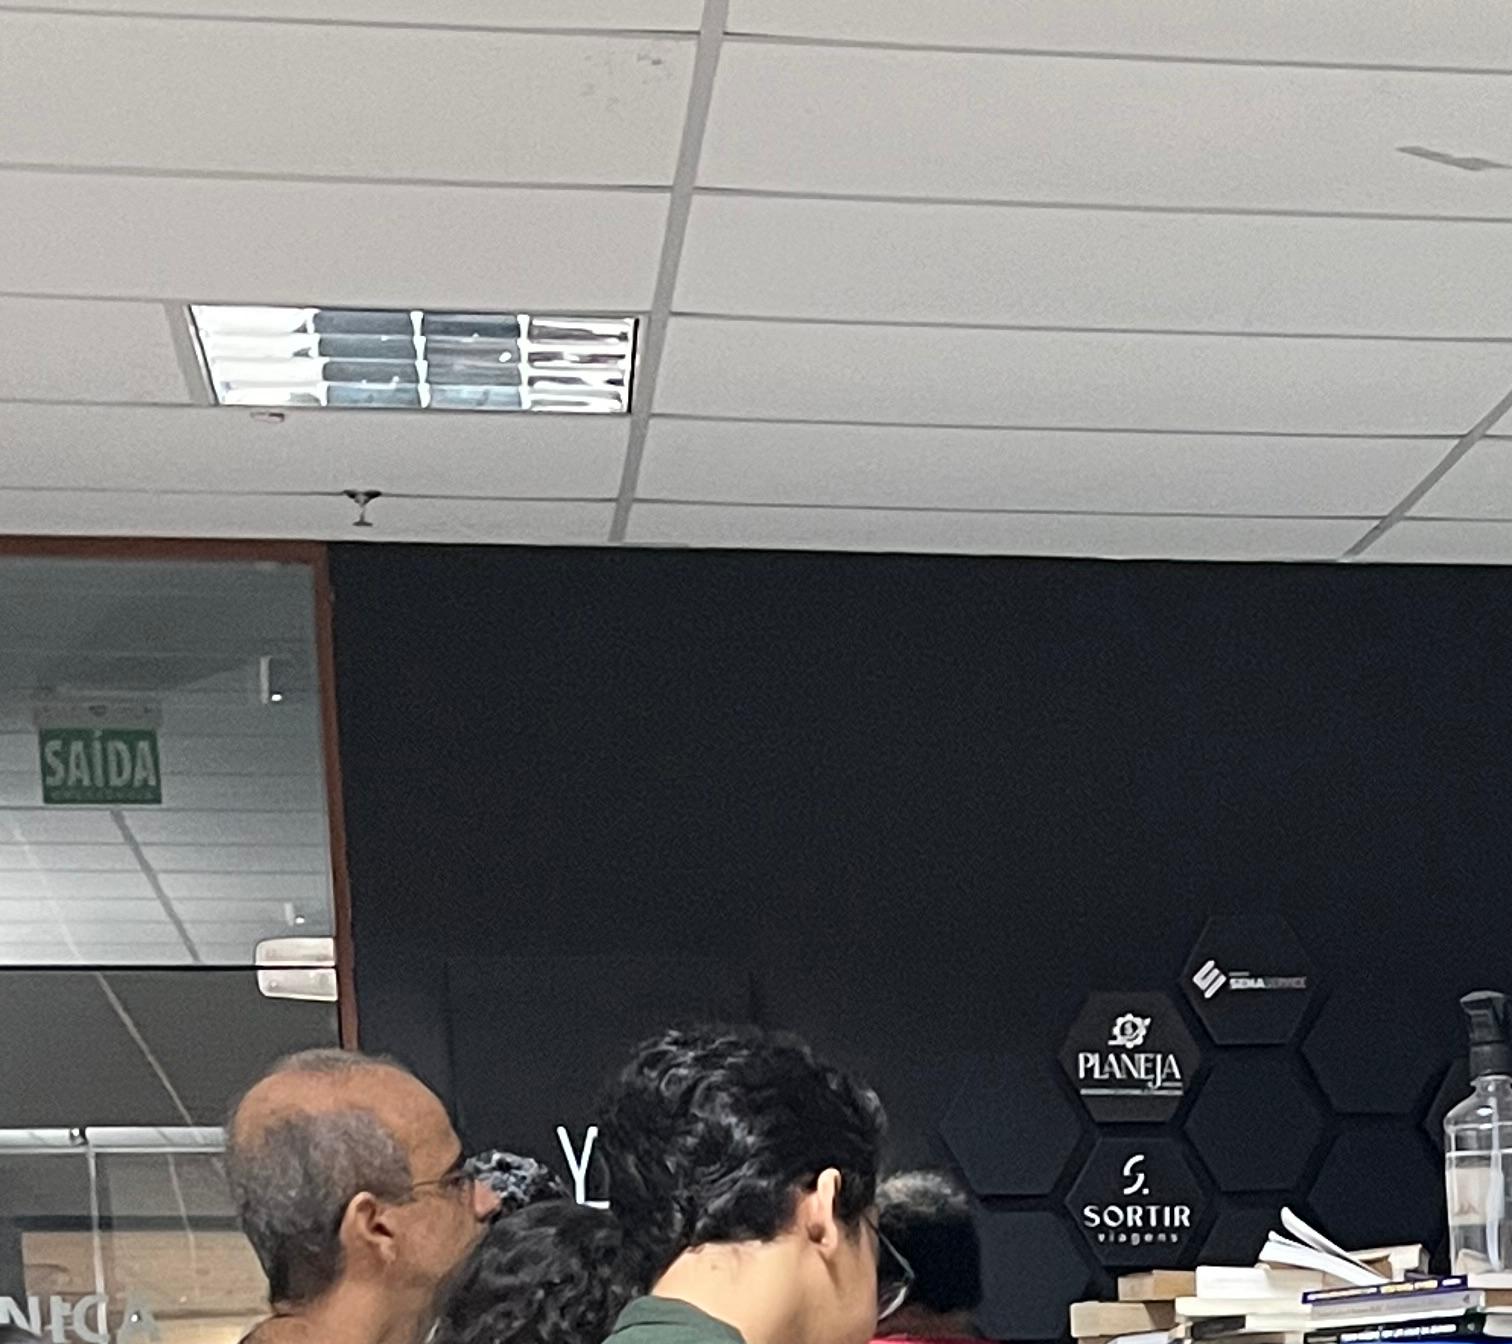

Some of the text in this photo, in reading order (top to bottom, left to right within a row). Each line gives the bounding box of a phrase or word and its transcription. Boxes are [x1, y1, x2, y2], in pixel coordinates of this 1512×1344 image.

[44, 729, 158, 788] SAÍDA
[1078, 1052, 1181, 1089] PLANEJA
[1083, 1205, 1191, 1228] SORTIR
[1097, 1230, 1178, 1246] viagens
